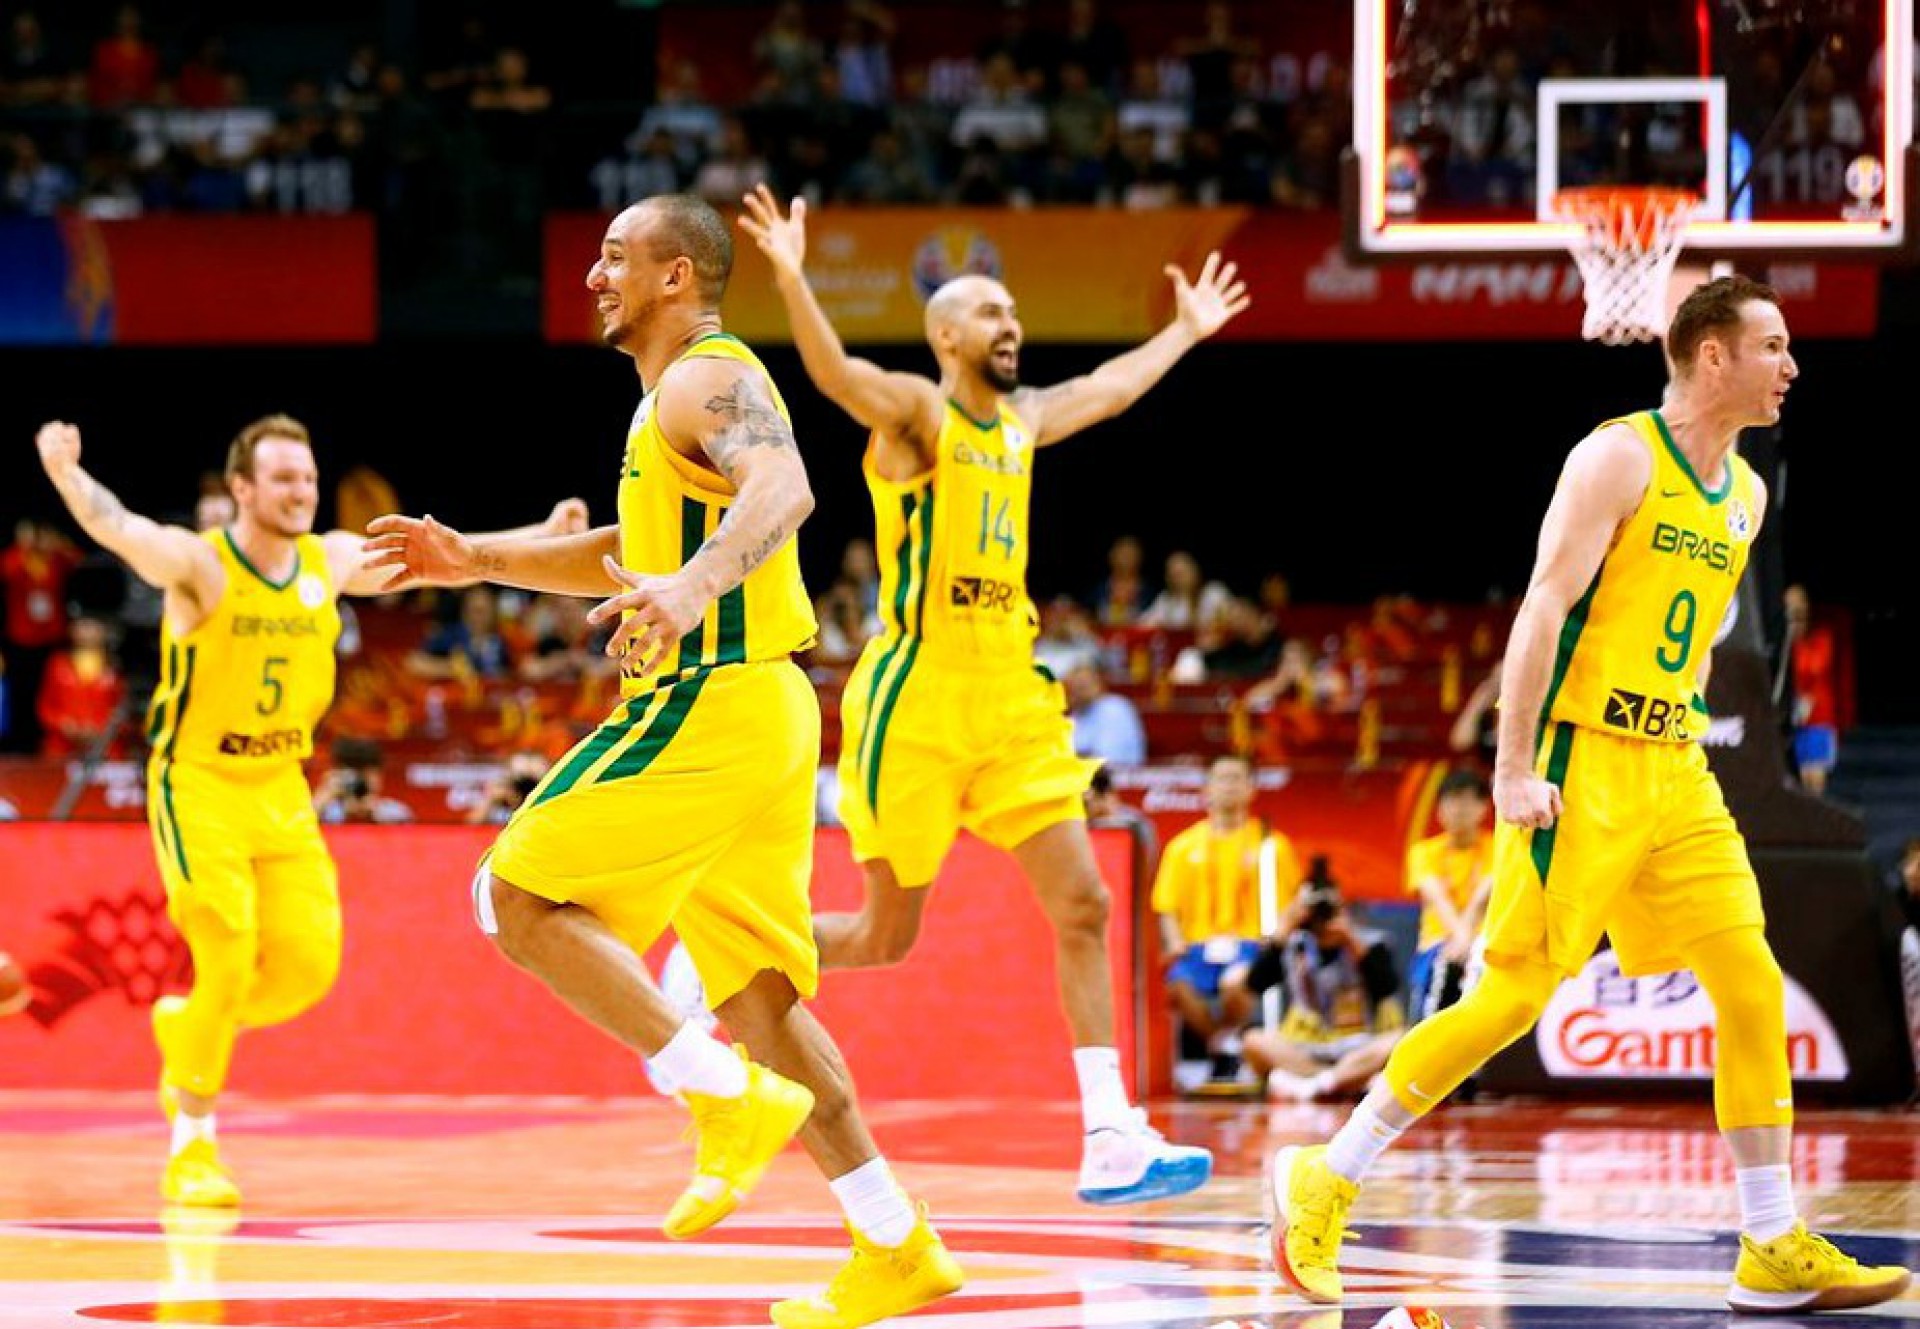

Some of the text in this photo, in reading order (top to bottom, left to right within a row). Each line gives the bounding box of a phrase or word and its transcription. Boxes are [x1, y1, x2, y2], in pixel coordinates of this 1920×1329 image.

[978, 491, 1015, 560] 14
[1652, 522, 1736, 576] BRASI
[1656, 588, 1696, 673] 9
[256, 657, 288, 716] 5
[1559, 1008, 1818, 1071] Gantn
